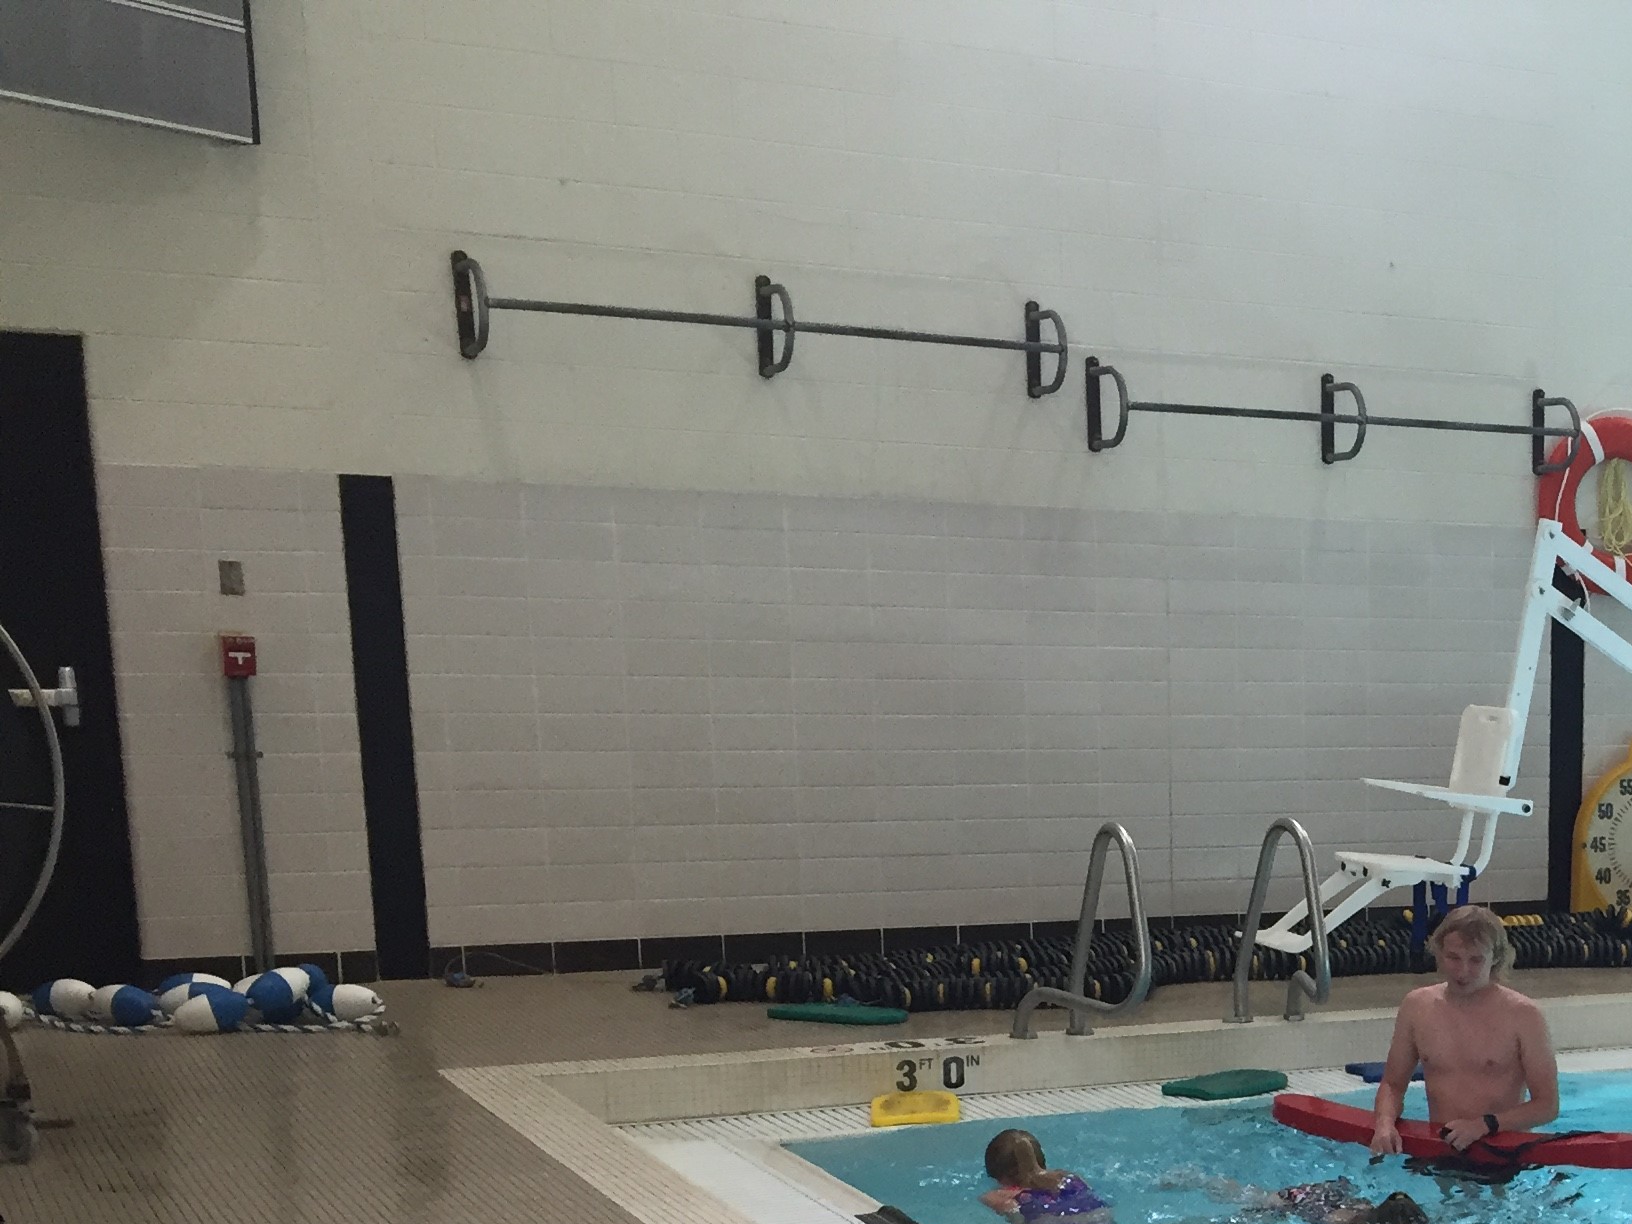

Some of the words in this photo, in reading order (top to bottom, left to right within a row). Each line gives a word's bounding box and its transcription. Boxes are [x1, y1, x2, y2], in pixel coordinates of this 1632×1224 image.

[1598, 803, 1613, 820] 50
[1590, 836, 1606, 853] 45
[1595, 867, 1611, 884] 40
[1616, 889, 1631, 906] 35
[896, 1059, 917, 1091] 3
[919, 1058, 933, 1070] FT
[943, 1056, 965, 1089] 0
[966, 1055, 980, 1067] IN
